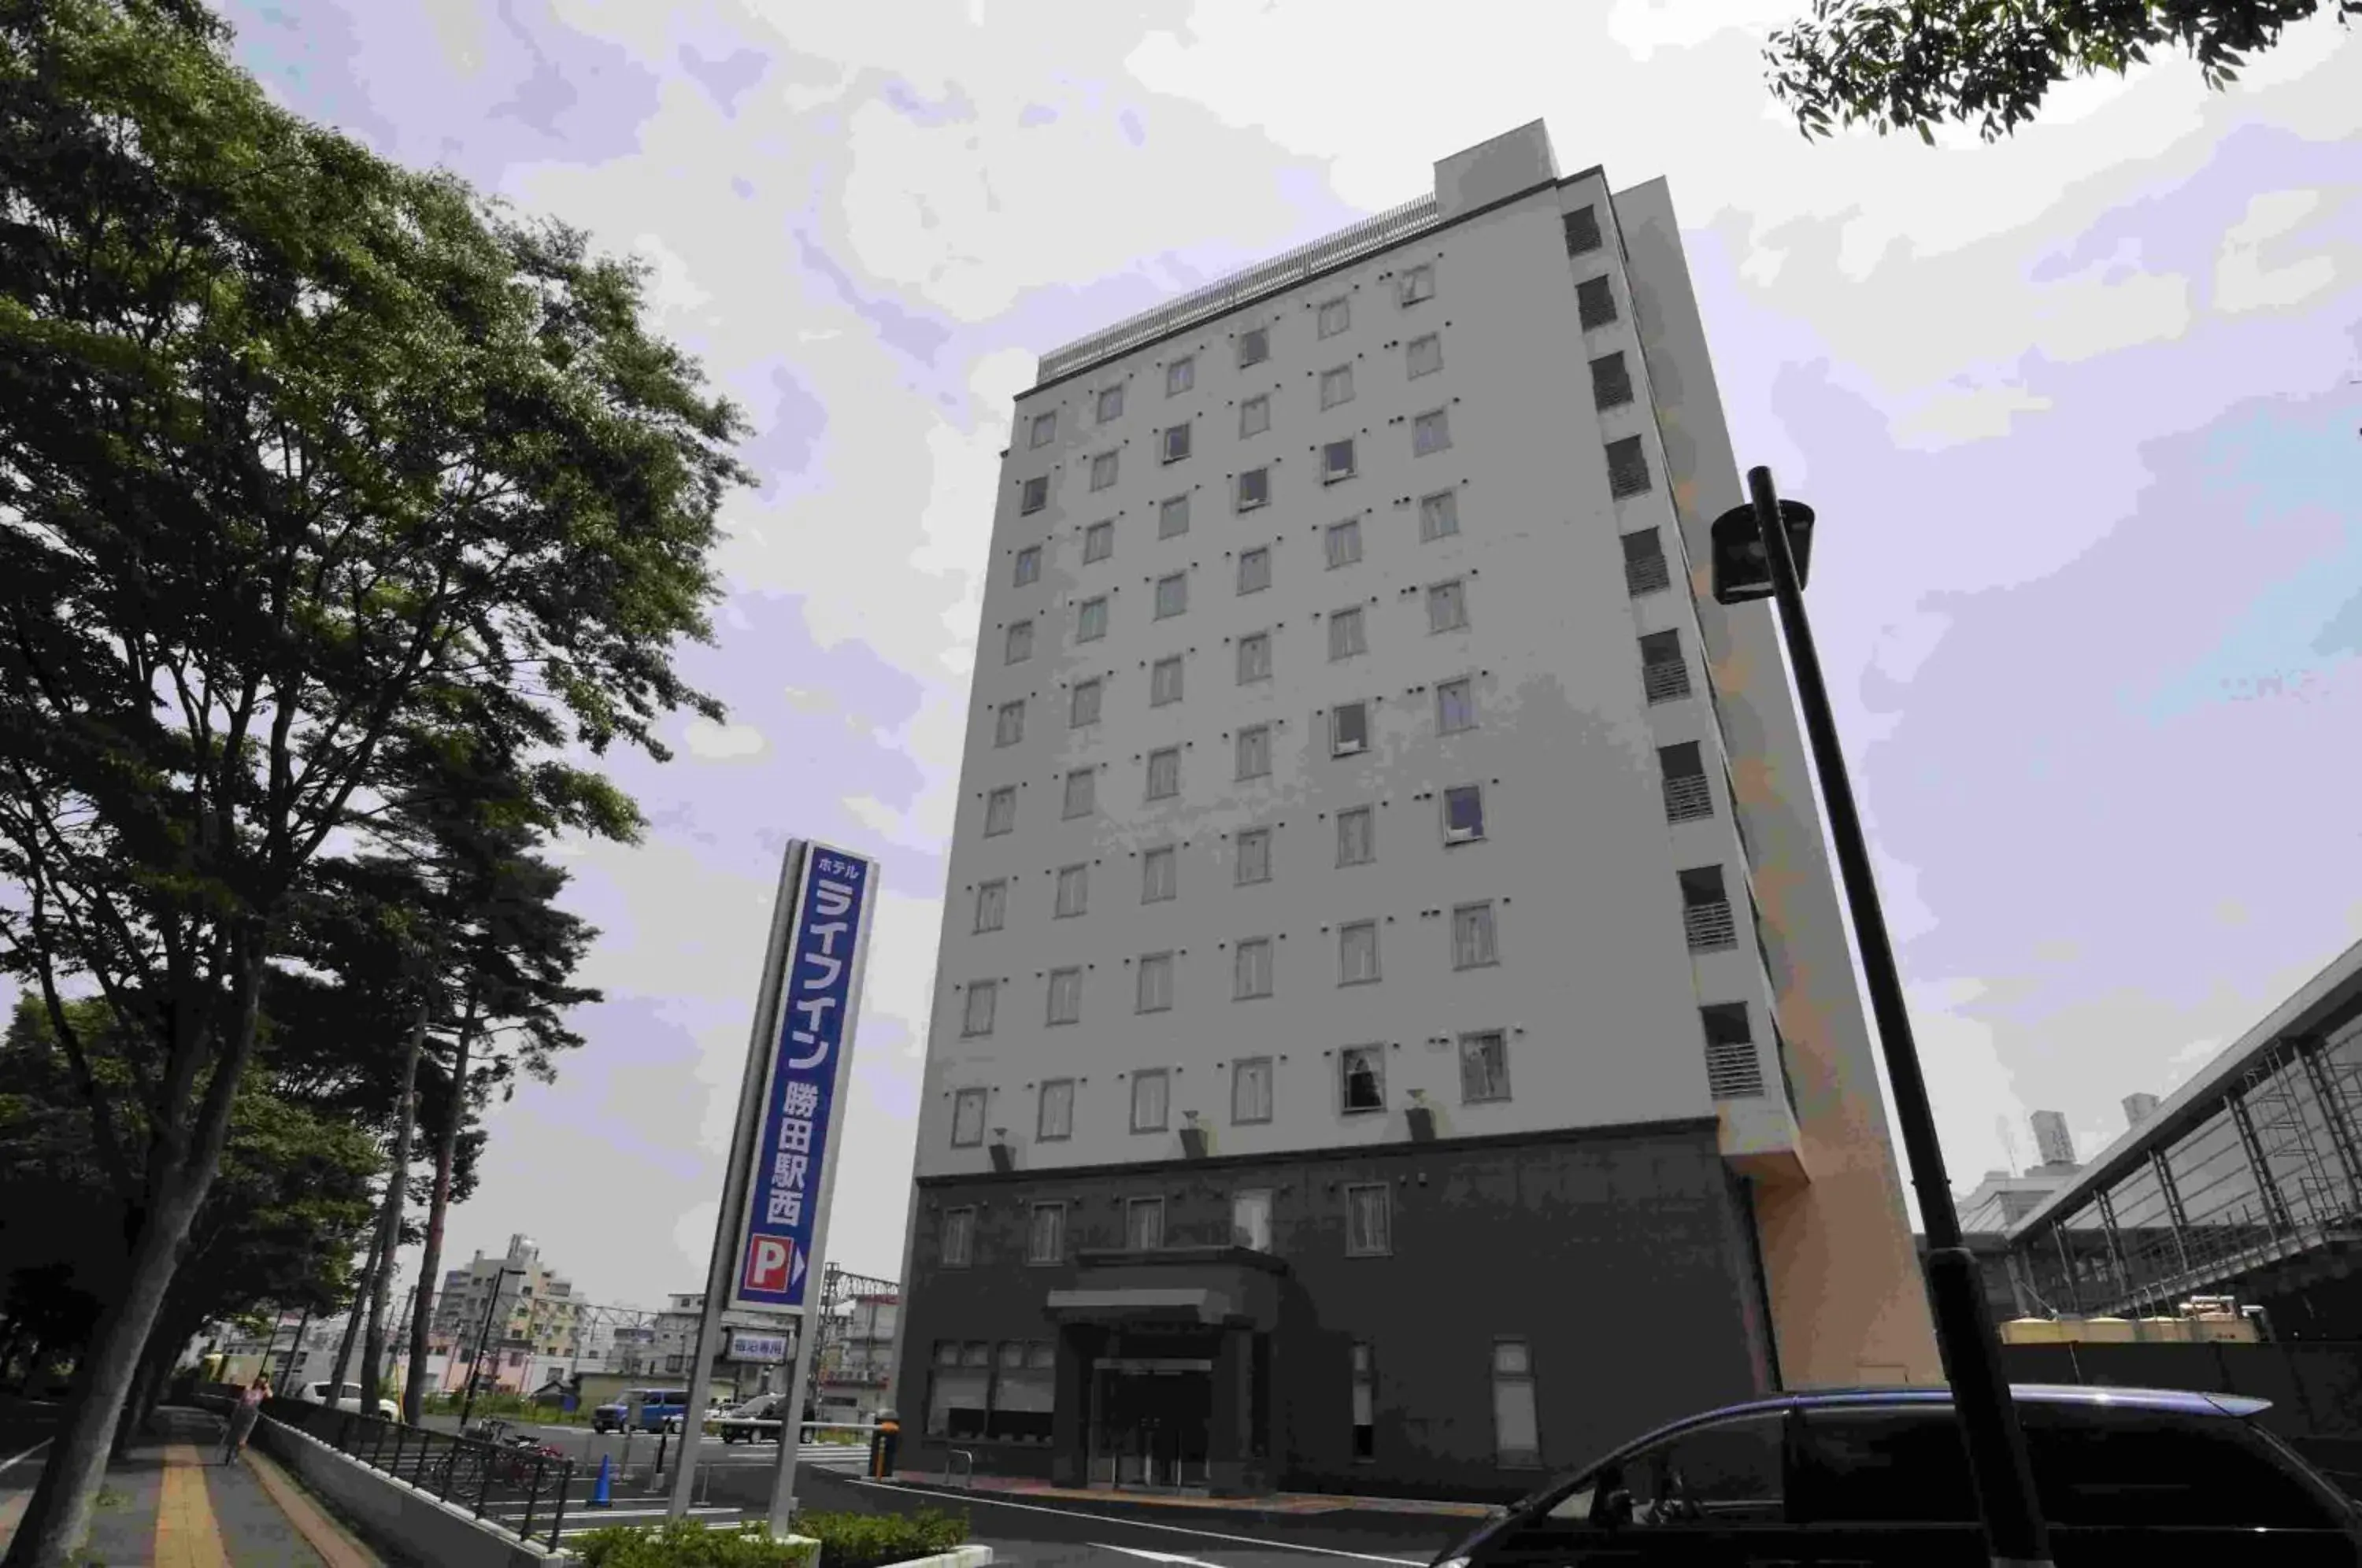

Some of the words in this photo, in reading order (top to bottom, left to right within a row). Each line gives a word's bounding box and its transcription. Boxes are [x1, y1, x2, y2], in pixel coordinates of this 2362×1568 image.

[818, 858, 859, 879] ホテル
[788, 879, 853, 1069] ライフイン
[766, 1081, 818, 1227] 勝田駅西
[753, 1241, 786, 1284] P
